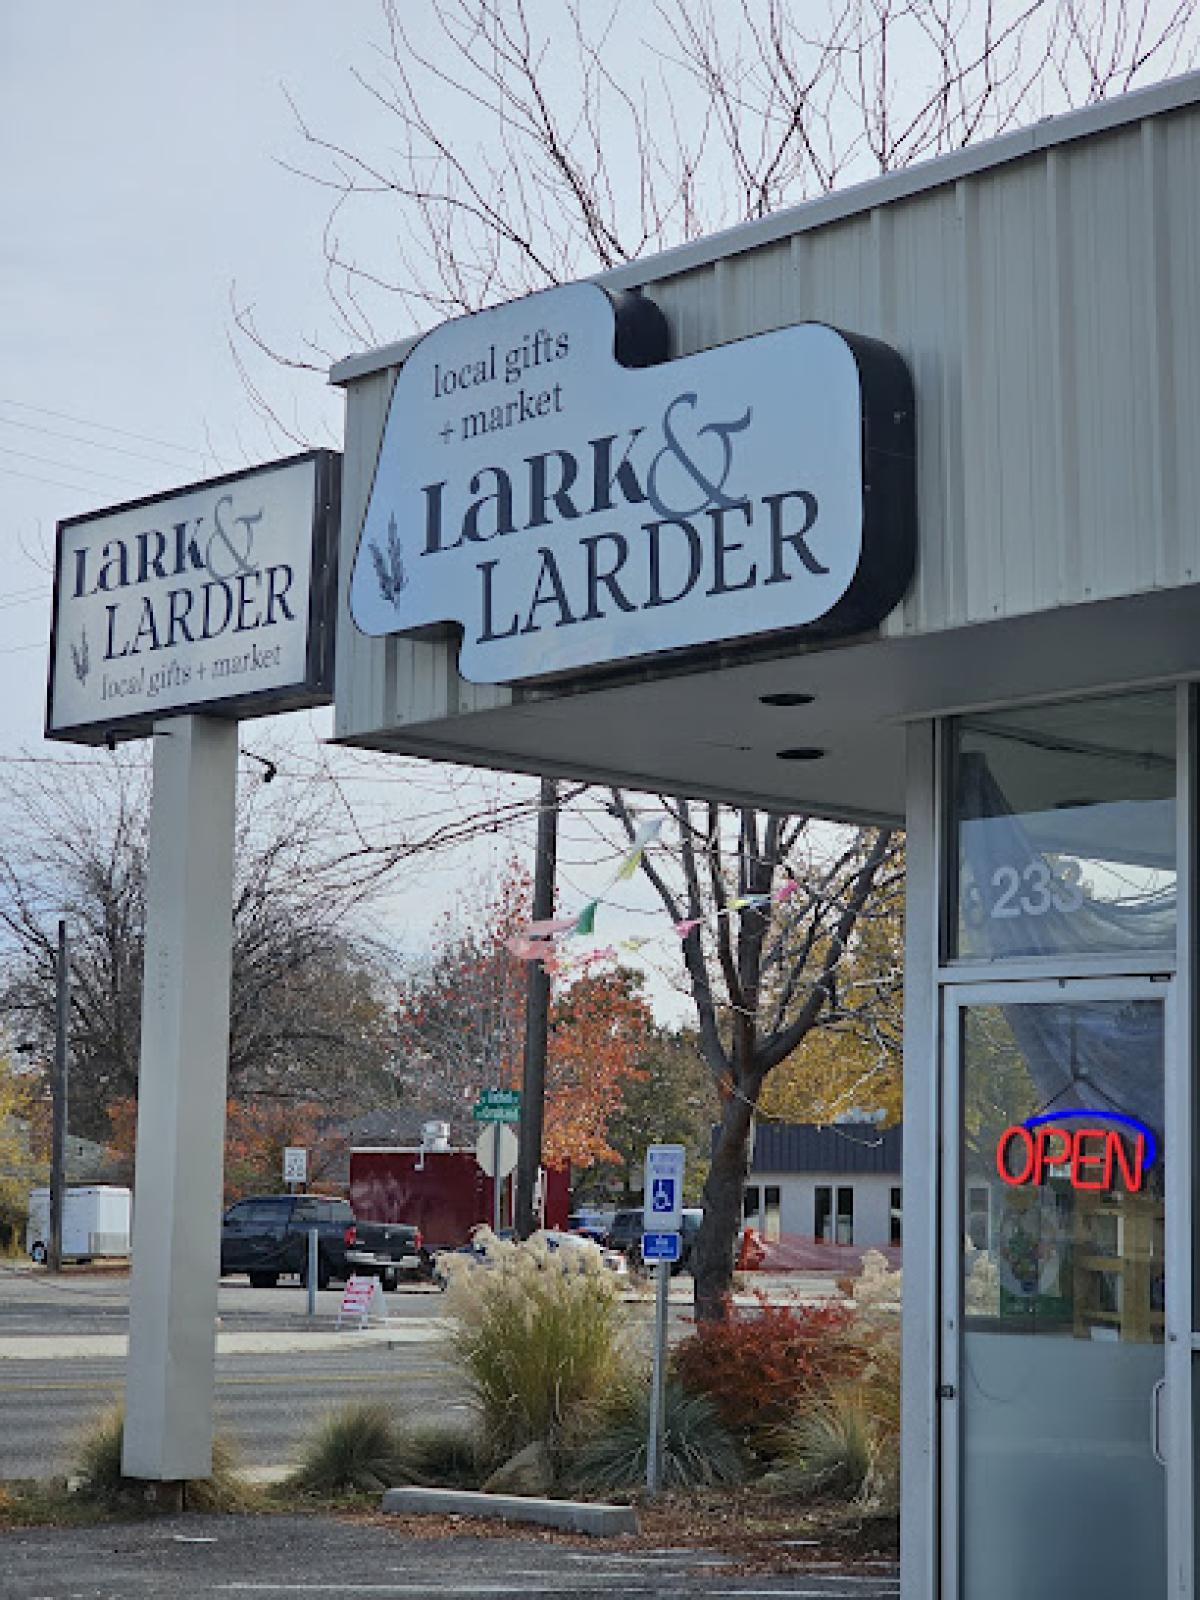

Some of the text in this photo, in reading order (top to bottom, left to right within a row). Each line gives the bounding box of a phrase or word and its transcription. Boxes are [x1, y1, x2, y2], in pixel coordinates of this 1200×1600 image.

[433, 328, 570, 397] local gifts
[461, 382, 565, 442] market
[475, 490, 831, 645] LARDER
[103, 563, 297, 660] LARDER
[100, 666, 145, 700] local
[147, 658, 192, 698] gifts
[211, 644, 282, 680] market
[991, 858, 1083, 919] 233
[996, 1125, 1145, 1192] OPEN
